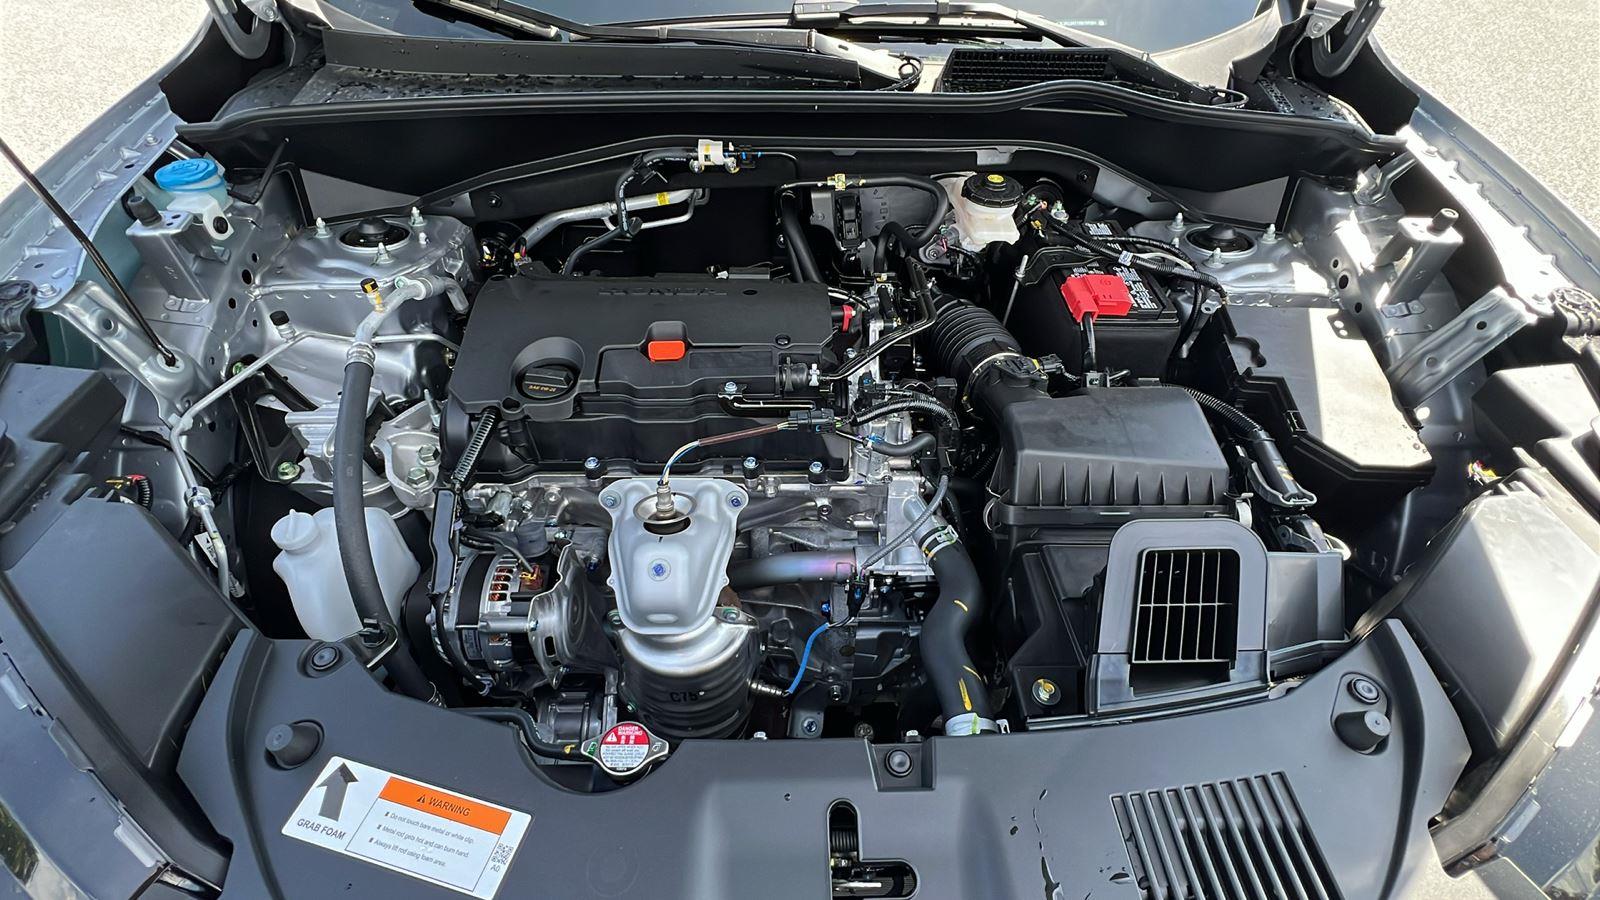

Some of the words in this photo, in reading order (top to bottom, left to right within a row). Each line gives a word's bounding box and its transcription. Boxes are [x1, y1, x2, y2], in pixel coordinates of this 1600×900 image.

[429, 796, 471, 816] WARNING
[297, 818, 320, 832] GRAB
[320, 825, 347, 840] FOAM
[382, 825, 397, 835] Metal
[374, 839, 391, 850] Always
